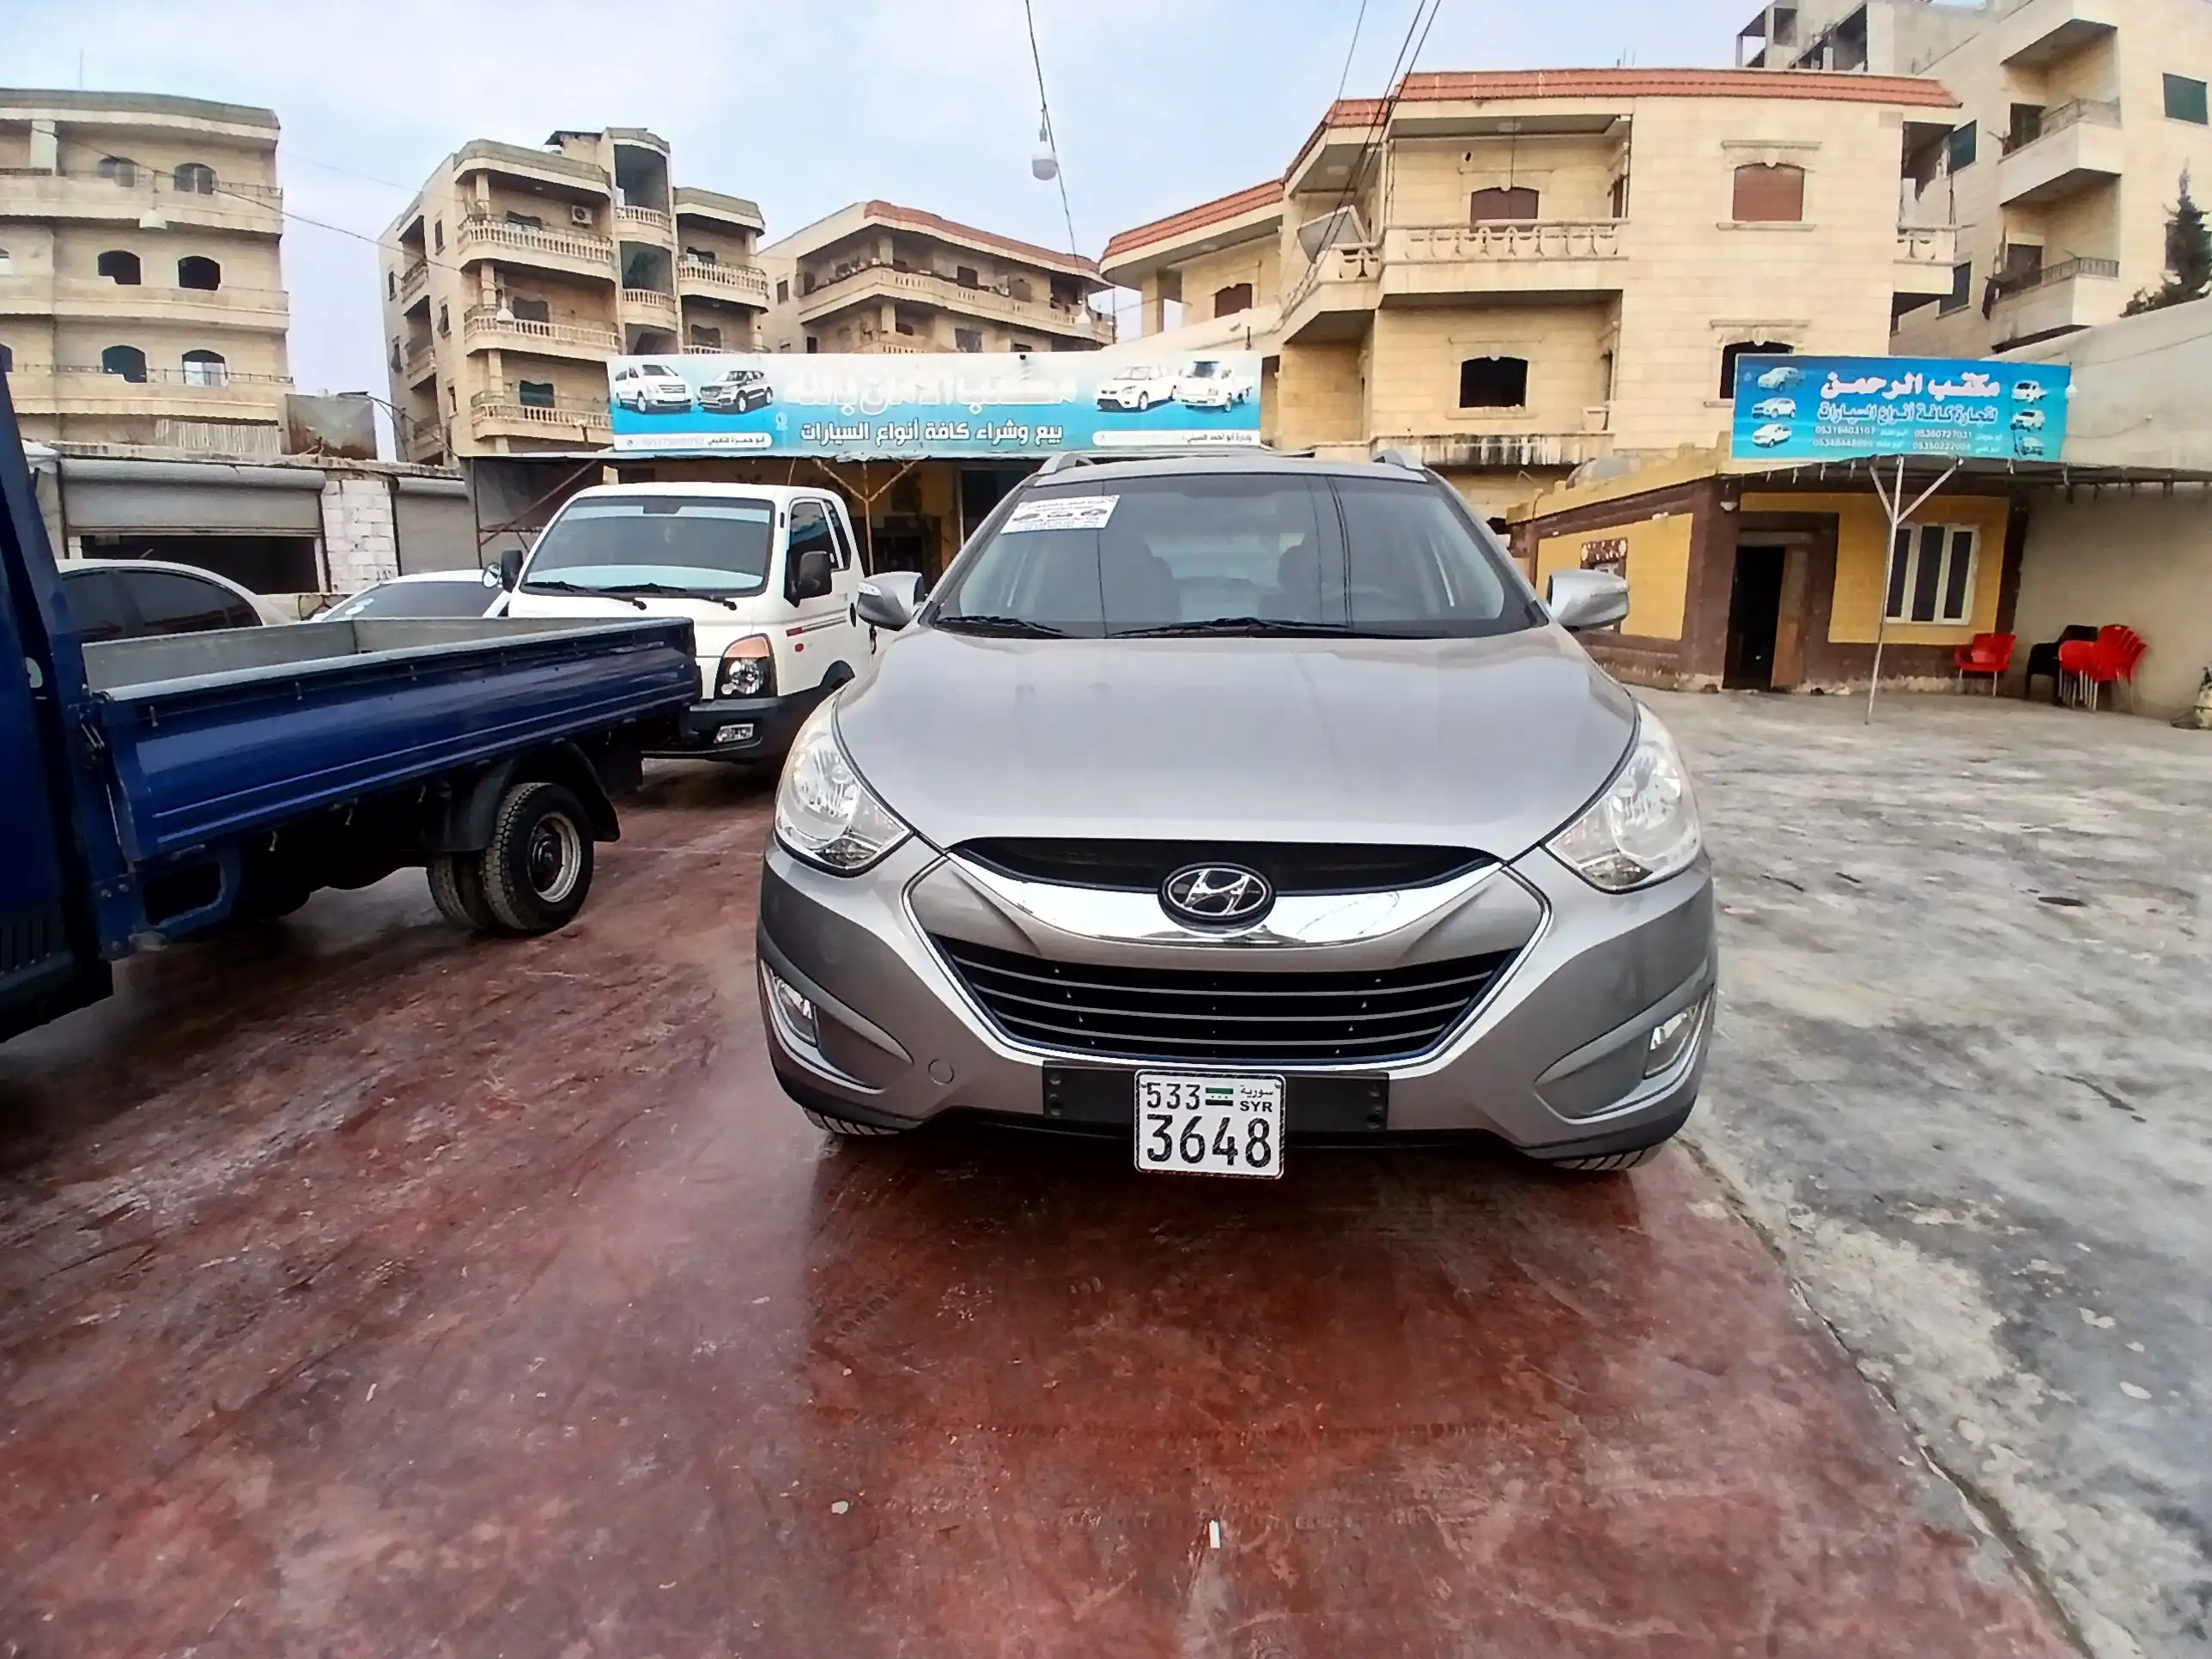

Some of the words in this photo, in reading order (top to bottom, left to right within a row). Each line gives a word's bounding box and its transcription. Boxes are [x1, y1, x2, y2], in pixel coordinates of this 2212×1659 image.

[1820, 371, 1923, 399] الرحمن
[1929, 372, 2000, 401] مكتب
[800, 421, 870, 446] السيارات
[876, 417, 920, 447] أنواع
[925, 421, 969, 441] كافة
[975, 418, 1029, 446] وشراء
[1034, 423, 1063, 446] بيع
[1146, 1082, 1200, 1109] 533
[1240, 1085, 1273, 1097] سورية
[1240, 1101, 1273, 1113] SYR
[1146, 1114, 1272, 1168] 3648
